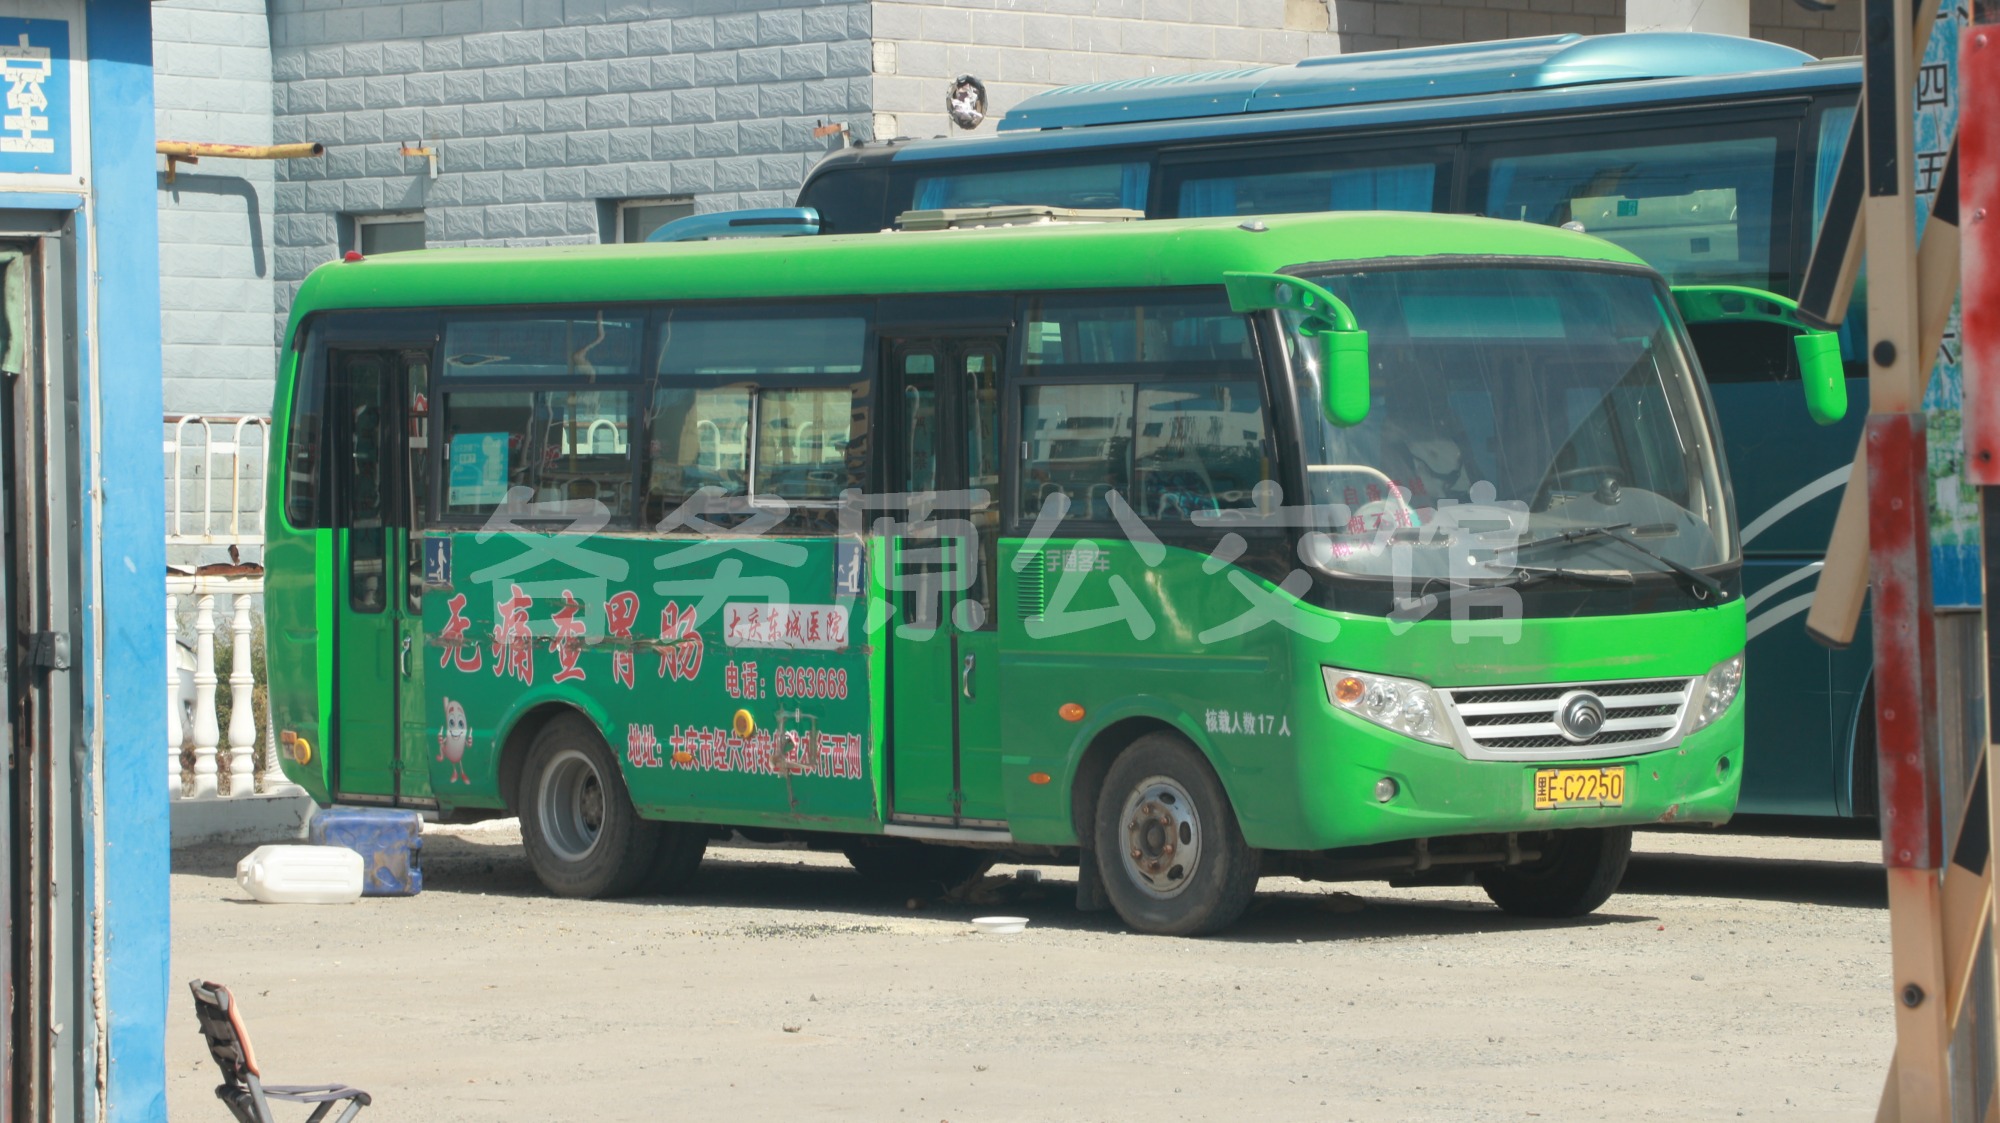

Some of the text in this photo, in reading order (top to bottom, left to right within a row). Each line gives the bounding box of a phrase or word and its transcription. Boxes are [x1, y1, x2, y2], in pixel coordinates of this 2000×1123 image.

[1046, 549, 1110, 572] 宇通客车
[440, 584, 704, 690] 无痛查胃肠
[728, 608, 845, 645] 大庆东城医院
[1205, 708, 1291, 737] 核载人数17人
